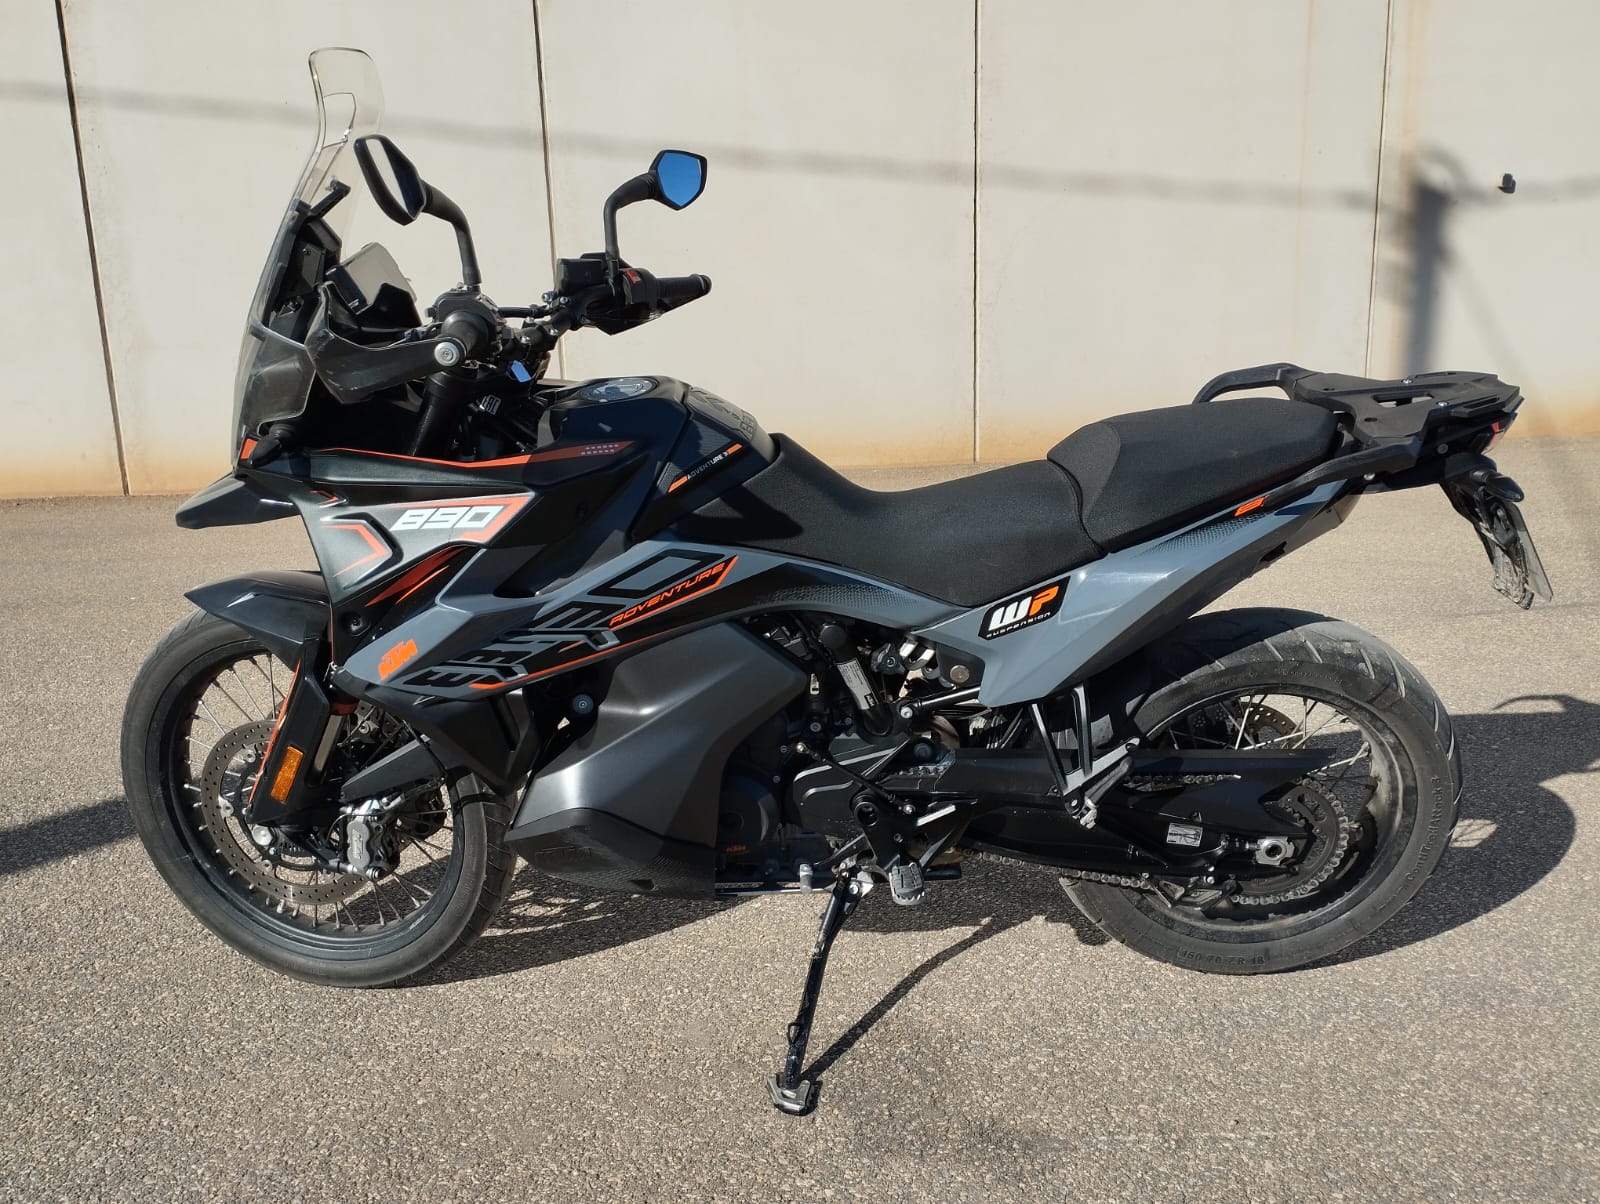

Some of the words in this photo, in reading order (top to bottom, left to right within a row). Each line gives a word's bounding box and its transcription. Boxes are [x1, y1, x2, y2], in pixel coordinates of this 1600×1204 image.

[687, 454, 723, 480] ADVENTURE
[390, 505, 505, 531] 890
[609, 562, 725, 627] ADVENTURE
[988, 585, 1060, 631] WP
[986, 612, 1051, 638] SUSPENSION
[378, 639, 418, 681] KTM
